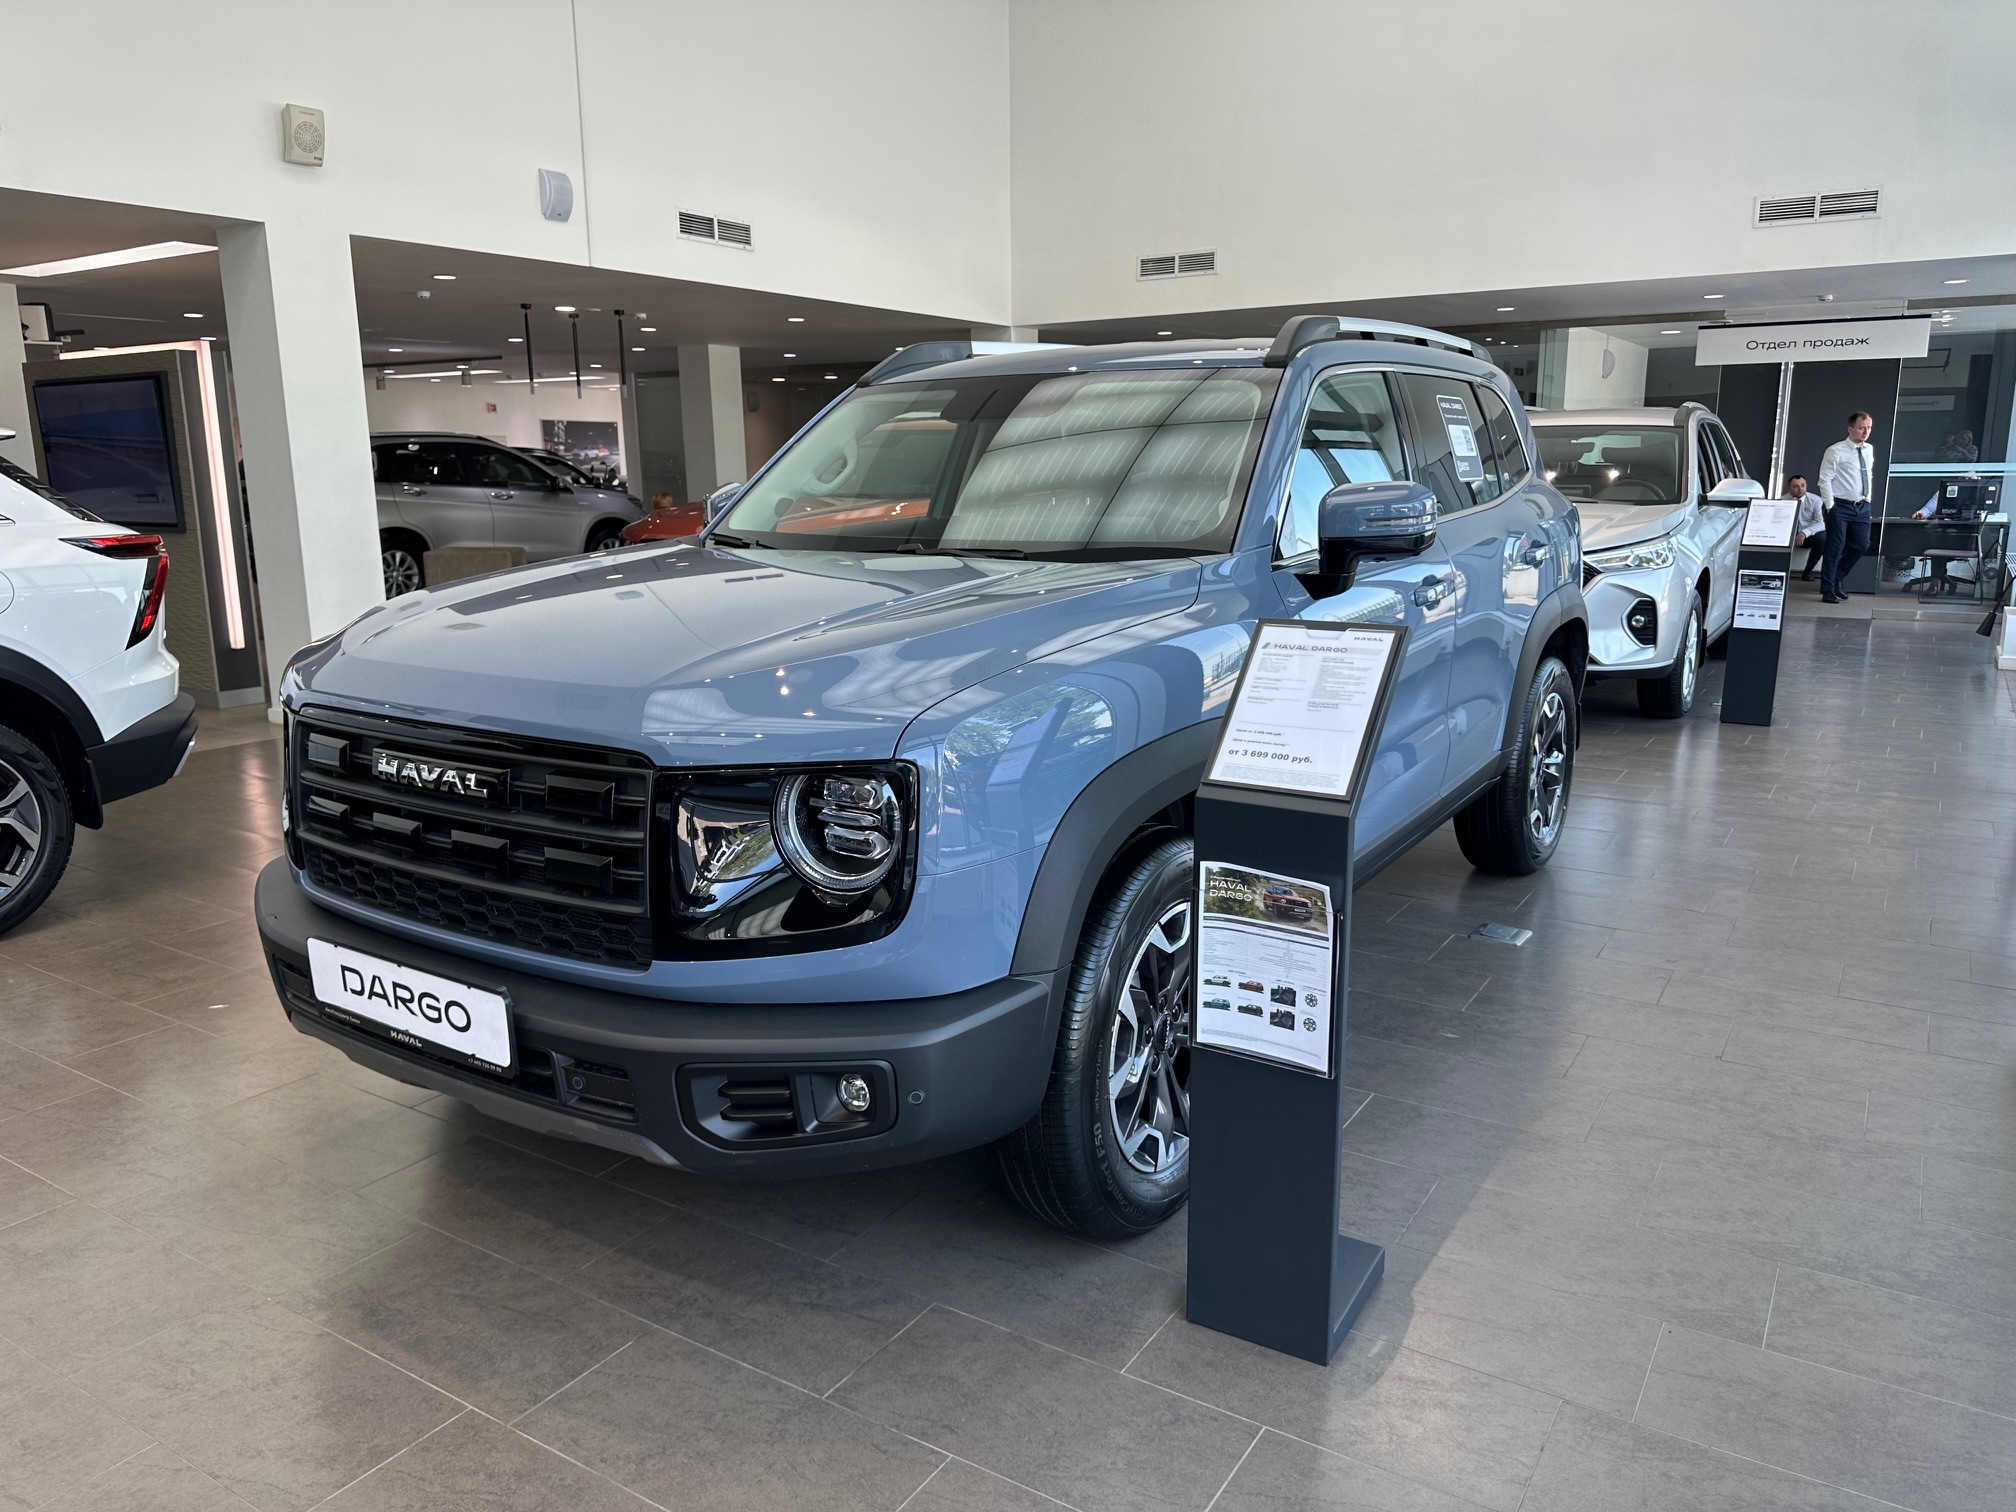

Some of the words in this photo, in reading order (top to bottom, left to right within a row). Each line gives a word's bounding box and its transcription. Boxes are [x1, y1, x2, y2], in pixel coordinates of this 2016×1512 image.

[1746, 340, 1797, 350] Отдел
[1802, 337, 1870, 349] продаж
[1273, 643, 1308, 651] HAVAL
[378, 754, 488, 798] HAVAL
[1210, 880, 1252, 893] HAVAL
[1209, 889, 1252, 902] DARGO
[341, 965, 471, 1033] DARGO
[390, 1030, 422, 1047] HAVAL
[1093, 1121, 1106, 1159] F50
